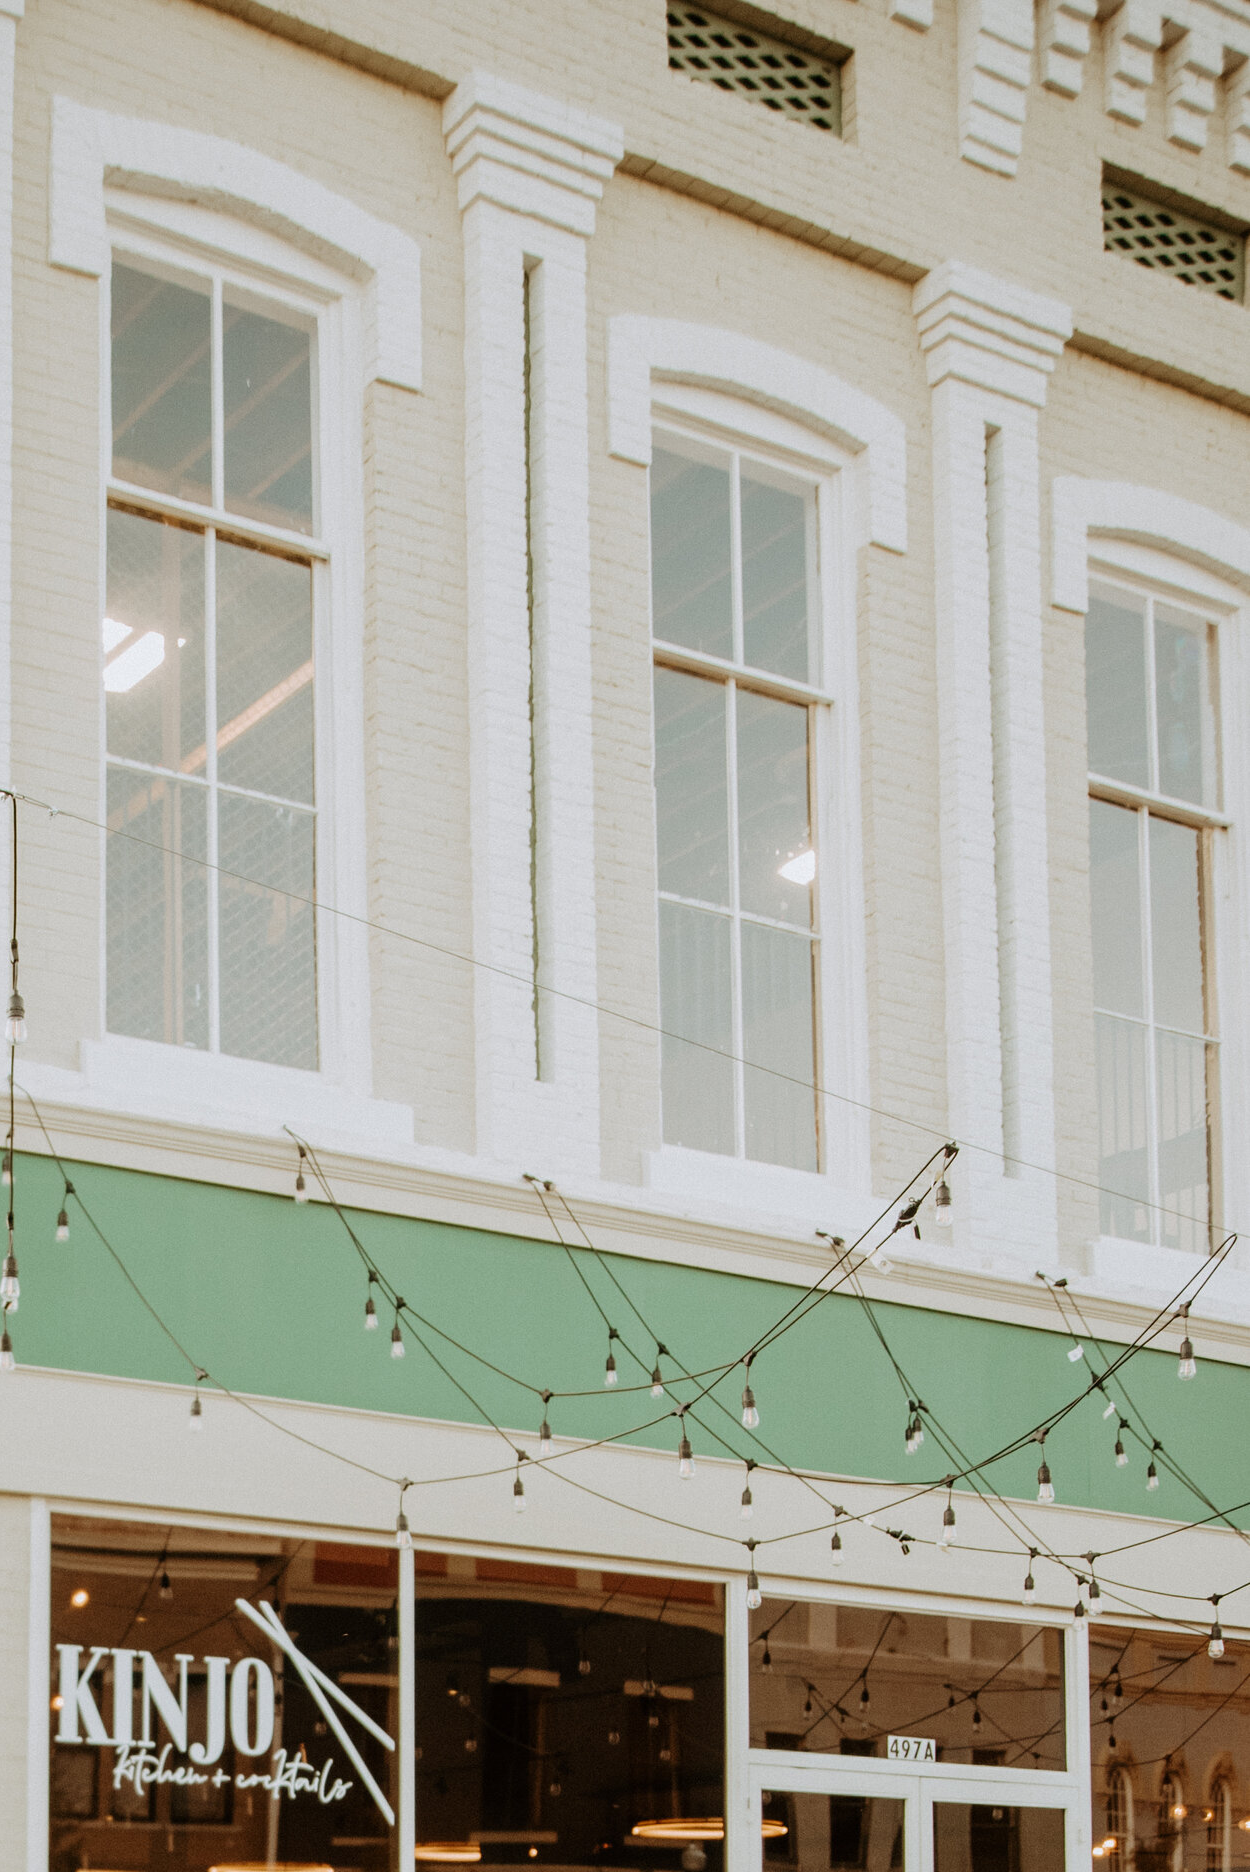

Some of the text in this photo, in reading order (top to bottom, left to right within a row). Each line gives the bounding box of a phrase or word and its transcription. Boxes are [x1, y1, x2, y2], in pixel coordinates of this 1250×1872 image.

[55, 1643, 275, 1765] KINJO
[113, 1743, 209, 1796] kitchen
[235, 1748, 353, 1804] cocktails
[890, 1739, 933, 1760] 497A
